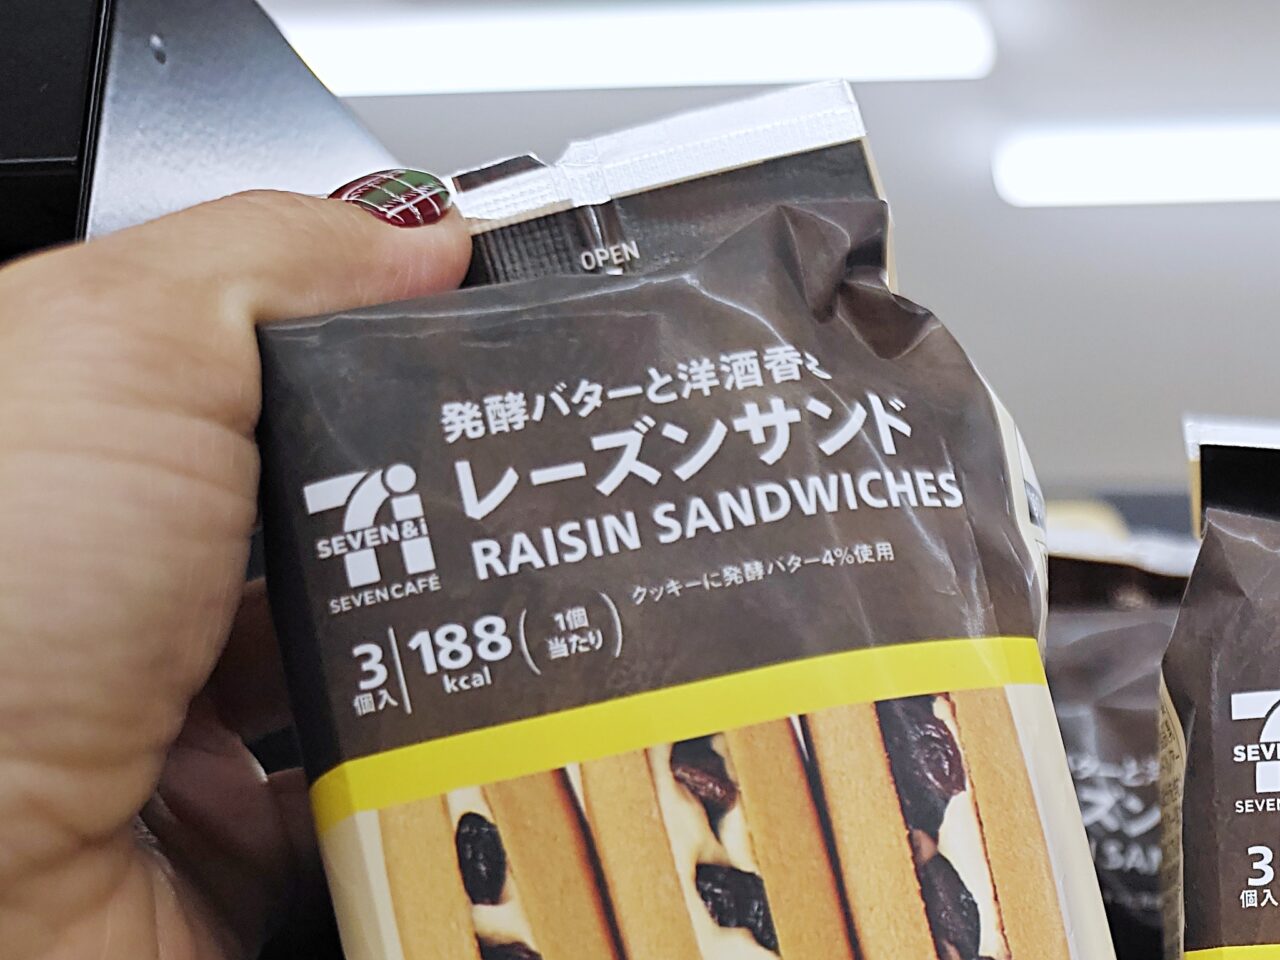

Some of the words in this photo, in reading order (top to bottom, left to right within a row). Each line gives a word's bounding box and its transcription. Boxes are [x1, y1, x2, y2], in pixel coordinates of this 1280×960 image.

[580, 240, 641, 271] OPEN
[454, 388, 913, 521] レーズンサンド
[471, 510, 641, 581] RAISIN
[658, 467, 965, 546] SANDWICHES
[630, 540, 896, 606] クッキーに発酵バター4%使用
[352, 642, 389, 692] 3
[407, 616, 513, 677] 188
[353, 689, 398, 716] 個入
[443, 665, 493, 695] kcal
[1246, 845, 1275, 887] 3
[1239, 888, 1279, 909] 個入
